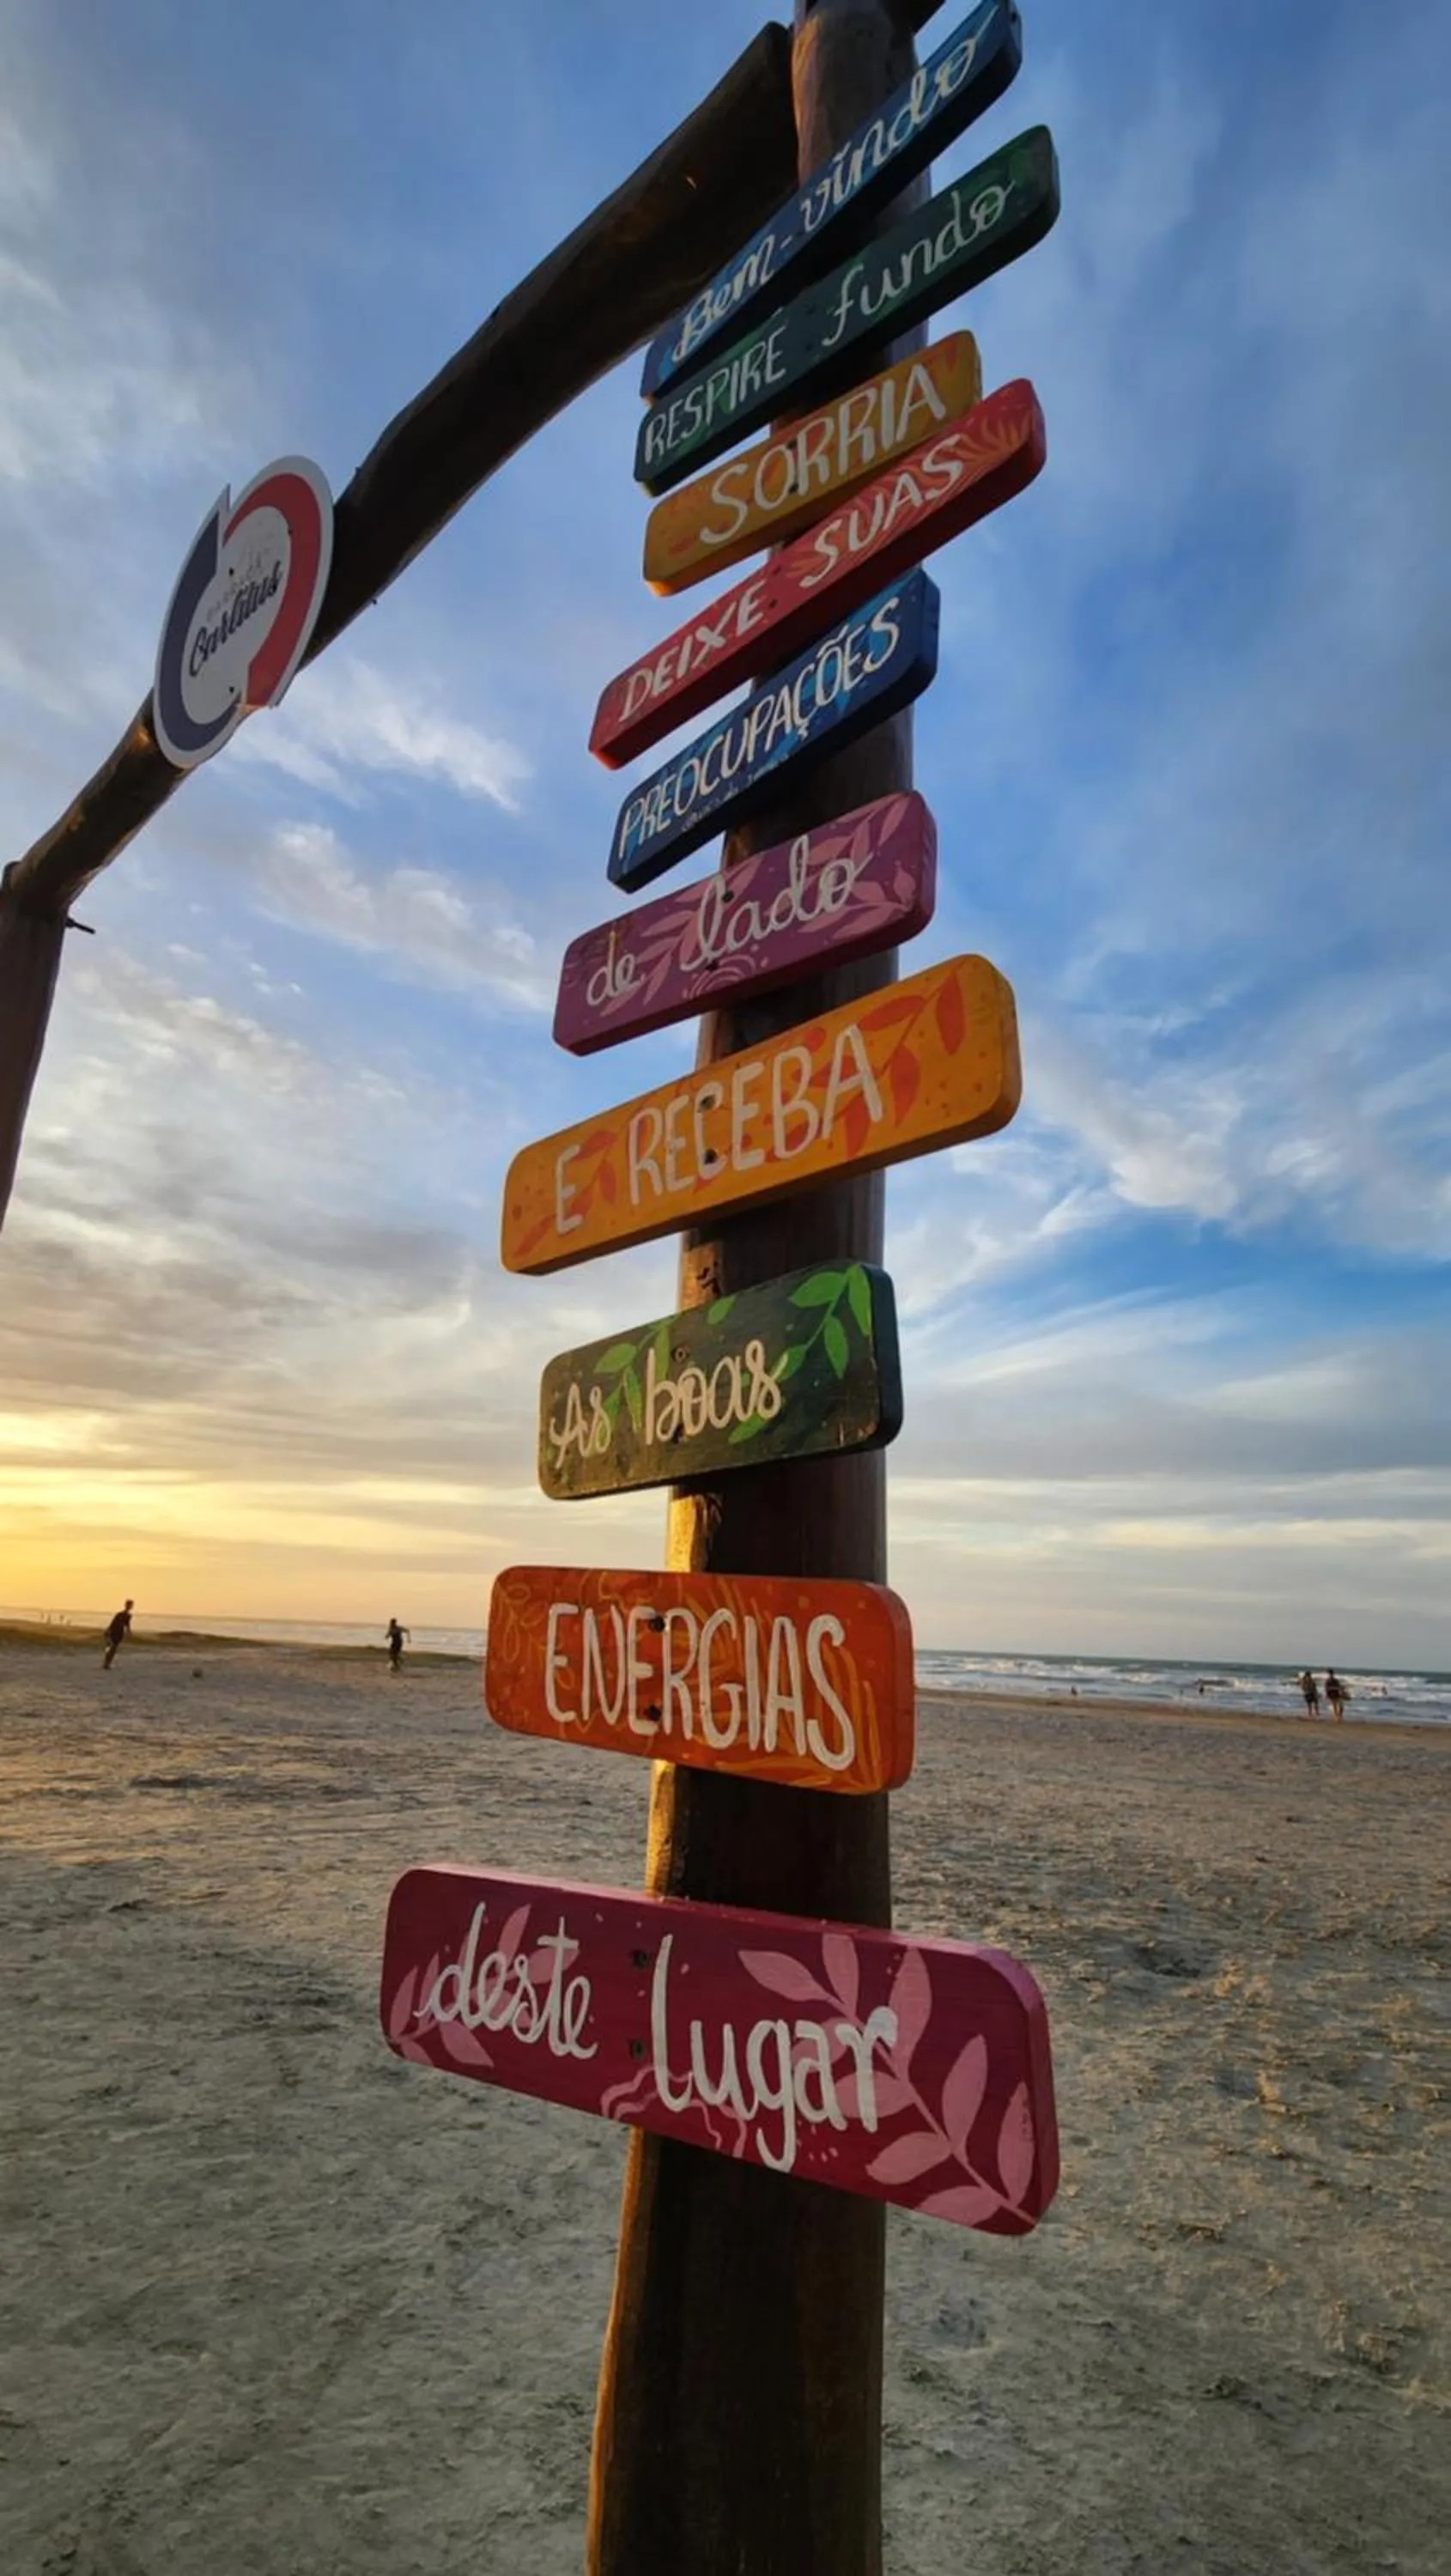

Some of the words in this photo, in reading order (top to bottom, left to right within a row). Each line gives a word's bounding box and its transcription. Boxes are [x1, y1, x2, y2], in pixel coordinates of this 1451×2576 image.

[671, 5, 999, 361] Bem-vindo
[643, 308, 789, 464] RESPIRE
[823, 179, 1016, 346] fundo
[700, 363, 947, 544] SORRIA
[618, 579, 768, 723] DEIXE
[799, 434, 963, 588] SUAS
[618, 597, 900, 859] PREOCUPAÇÕES
[586, 930, 644, 1005] de
[679, 835, 874, 972] lado
[556, 1145, 582, 1235] E
[629, 1023, 883, 1206] RECEBA
[549, 1382, 610, 1467] As
[646, 1339, 788, 1446] boas
[544, 1603, 856, 1771] ENERGIAS
[413, 1901, 598, 2059] deste
[651, 1935, 897, 2172] lugar
